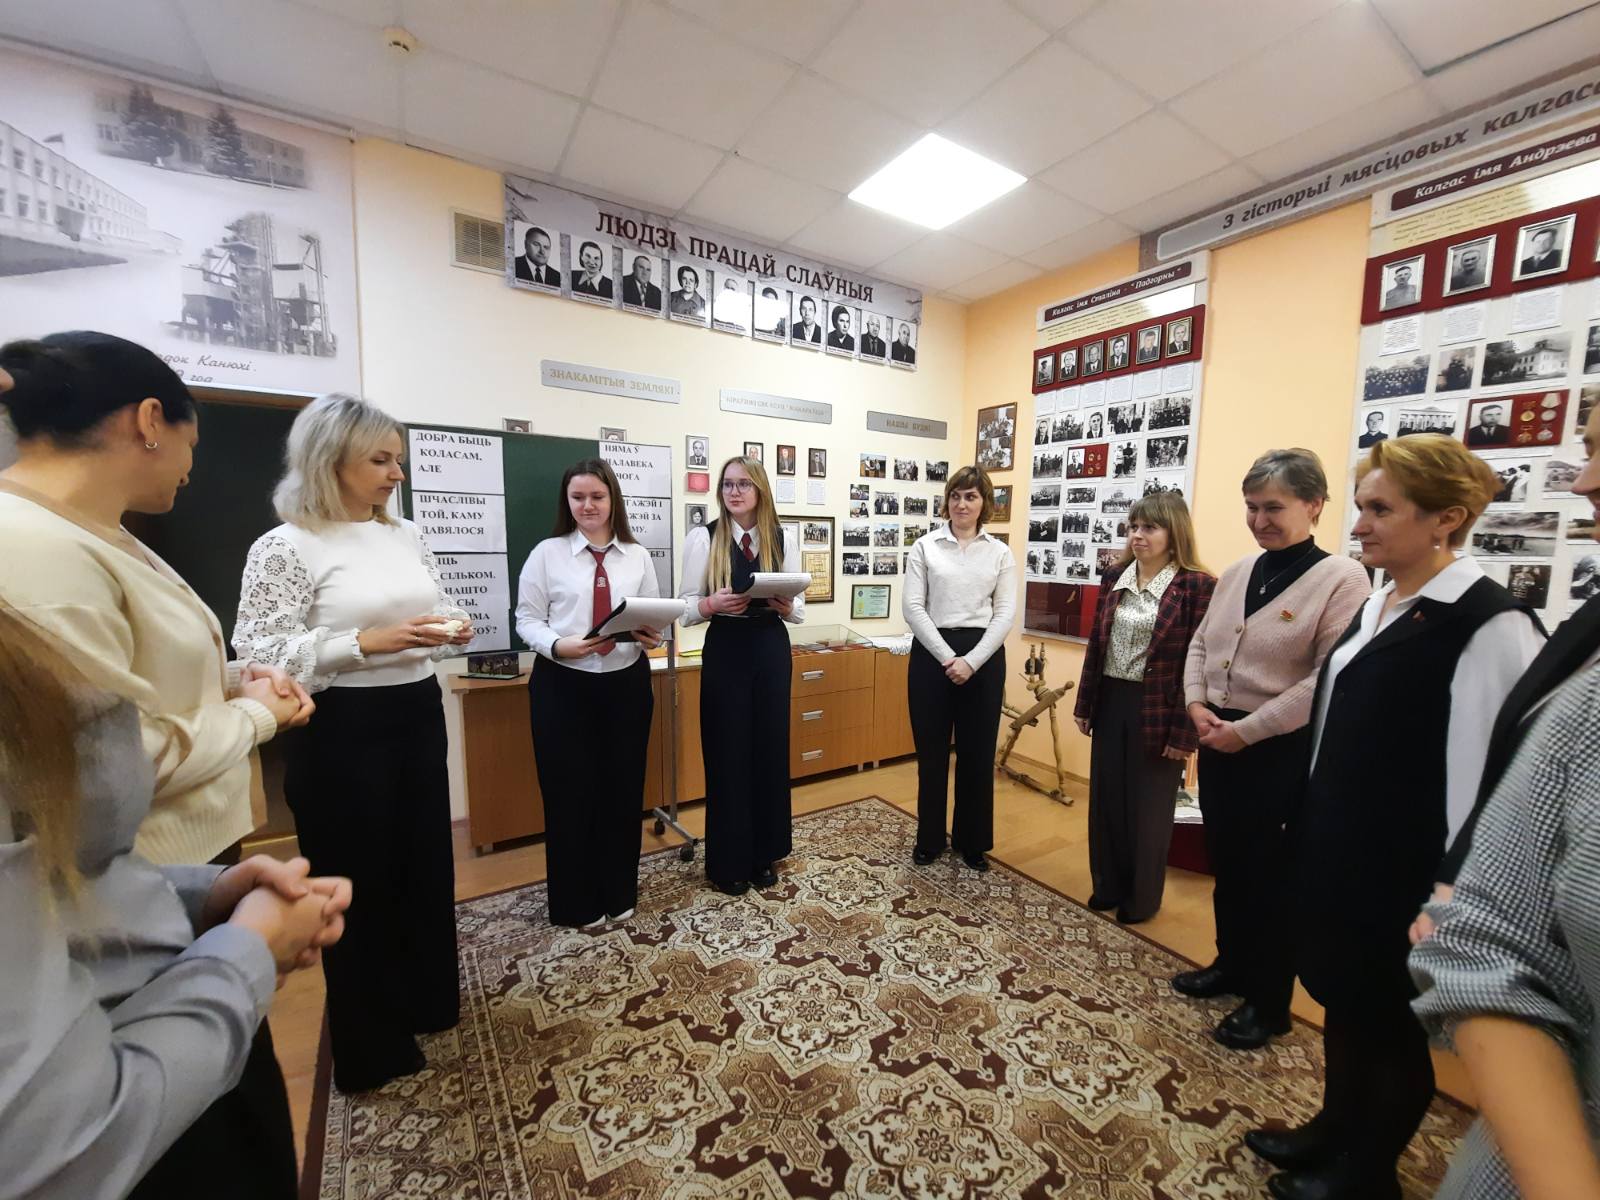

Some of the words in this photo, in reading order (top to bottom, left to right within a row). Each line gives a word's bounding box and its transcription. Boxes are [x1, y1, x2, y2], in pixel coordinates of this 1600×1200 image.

[1414, 174, 1467, 199] Калгас
[1473, 163, 1503, 180] імя
[1509, 132, 1597, 168] Андрэева
[1222, 213, 1234, 230] З
[1241, 175, 1332, 223] гісторыі
[1340, 128, 1470, 187] мясцовых
[595, 211, 677, 251] ЛЮДЗІ
[688, 236, 777, 278] ПРАЦАЙ
[786, 264, 873, 303] СЛАЎНЫЯ
[550, 367, 625, 389] ЗНАКАМІТЫЯ
[630, 380, 674, 395] ЗЕМЛЯКІ
[416, 432, 455, 444] ДОБРА
[458, 436, 492, 447] БЫЦЬ
[604, 444, 632, 454] НЯМА
[417, 464, 442, 473] АЛЕ
[616, 472, 640, 481] ЧОГА
[419, 494, 486, 505] ШЧАСЛІВЫ
[626, 499, 657, 508] ГАЖЭЙ
[451, 511, 485, 520] КАМУ
[629, 511, 650, 520] ЖЭЙ
[651, 513, 662, 521] ЗА
[422, 525, 484, 535] ДАВЯЛОСЯ
[440, 571, 496, 580] СІЛЬКОМ.
[444, 585, 488, 595] НАШТО
